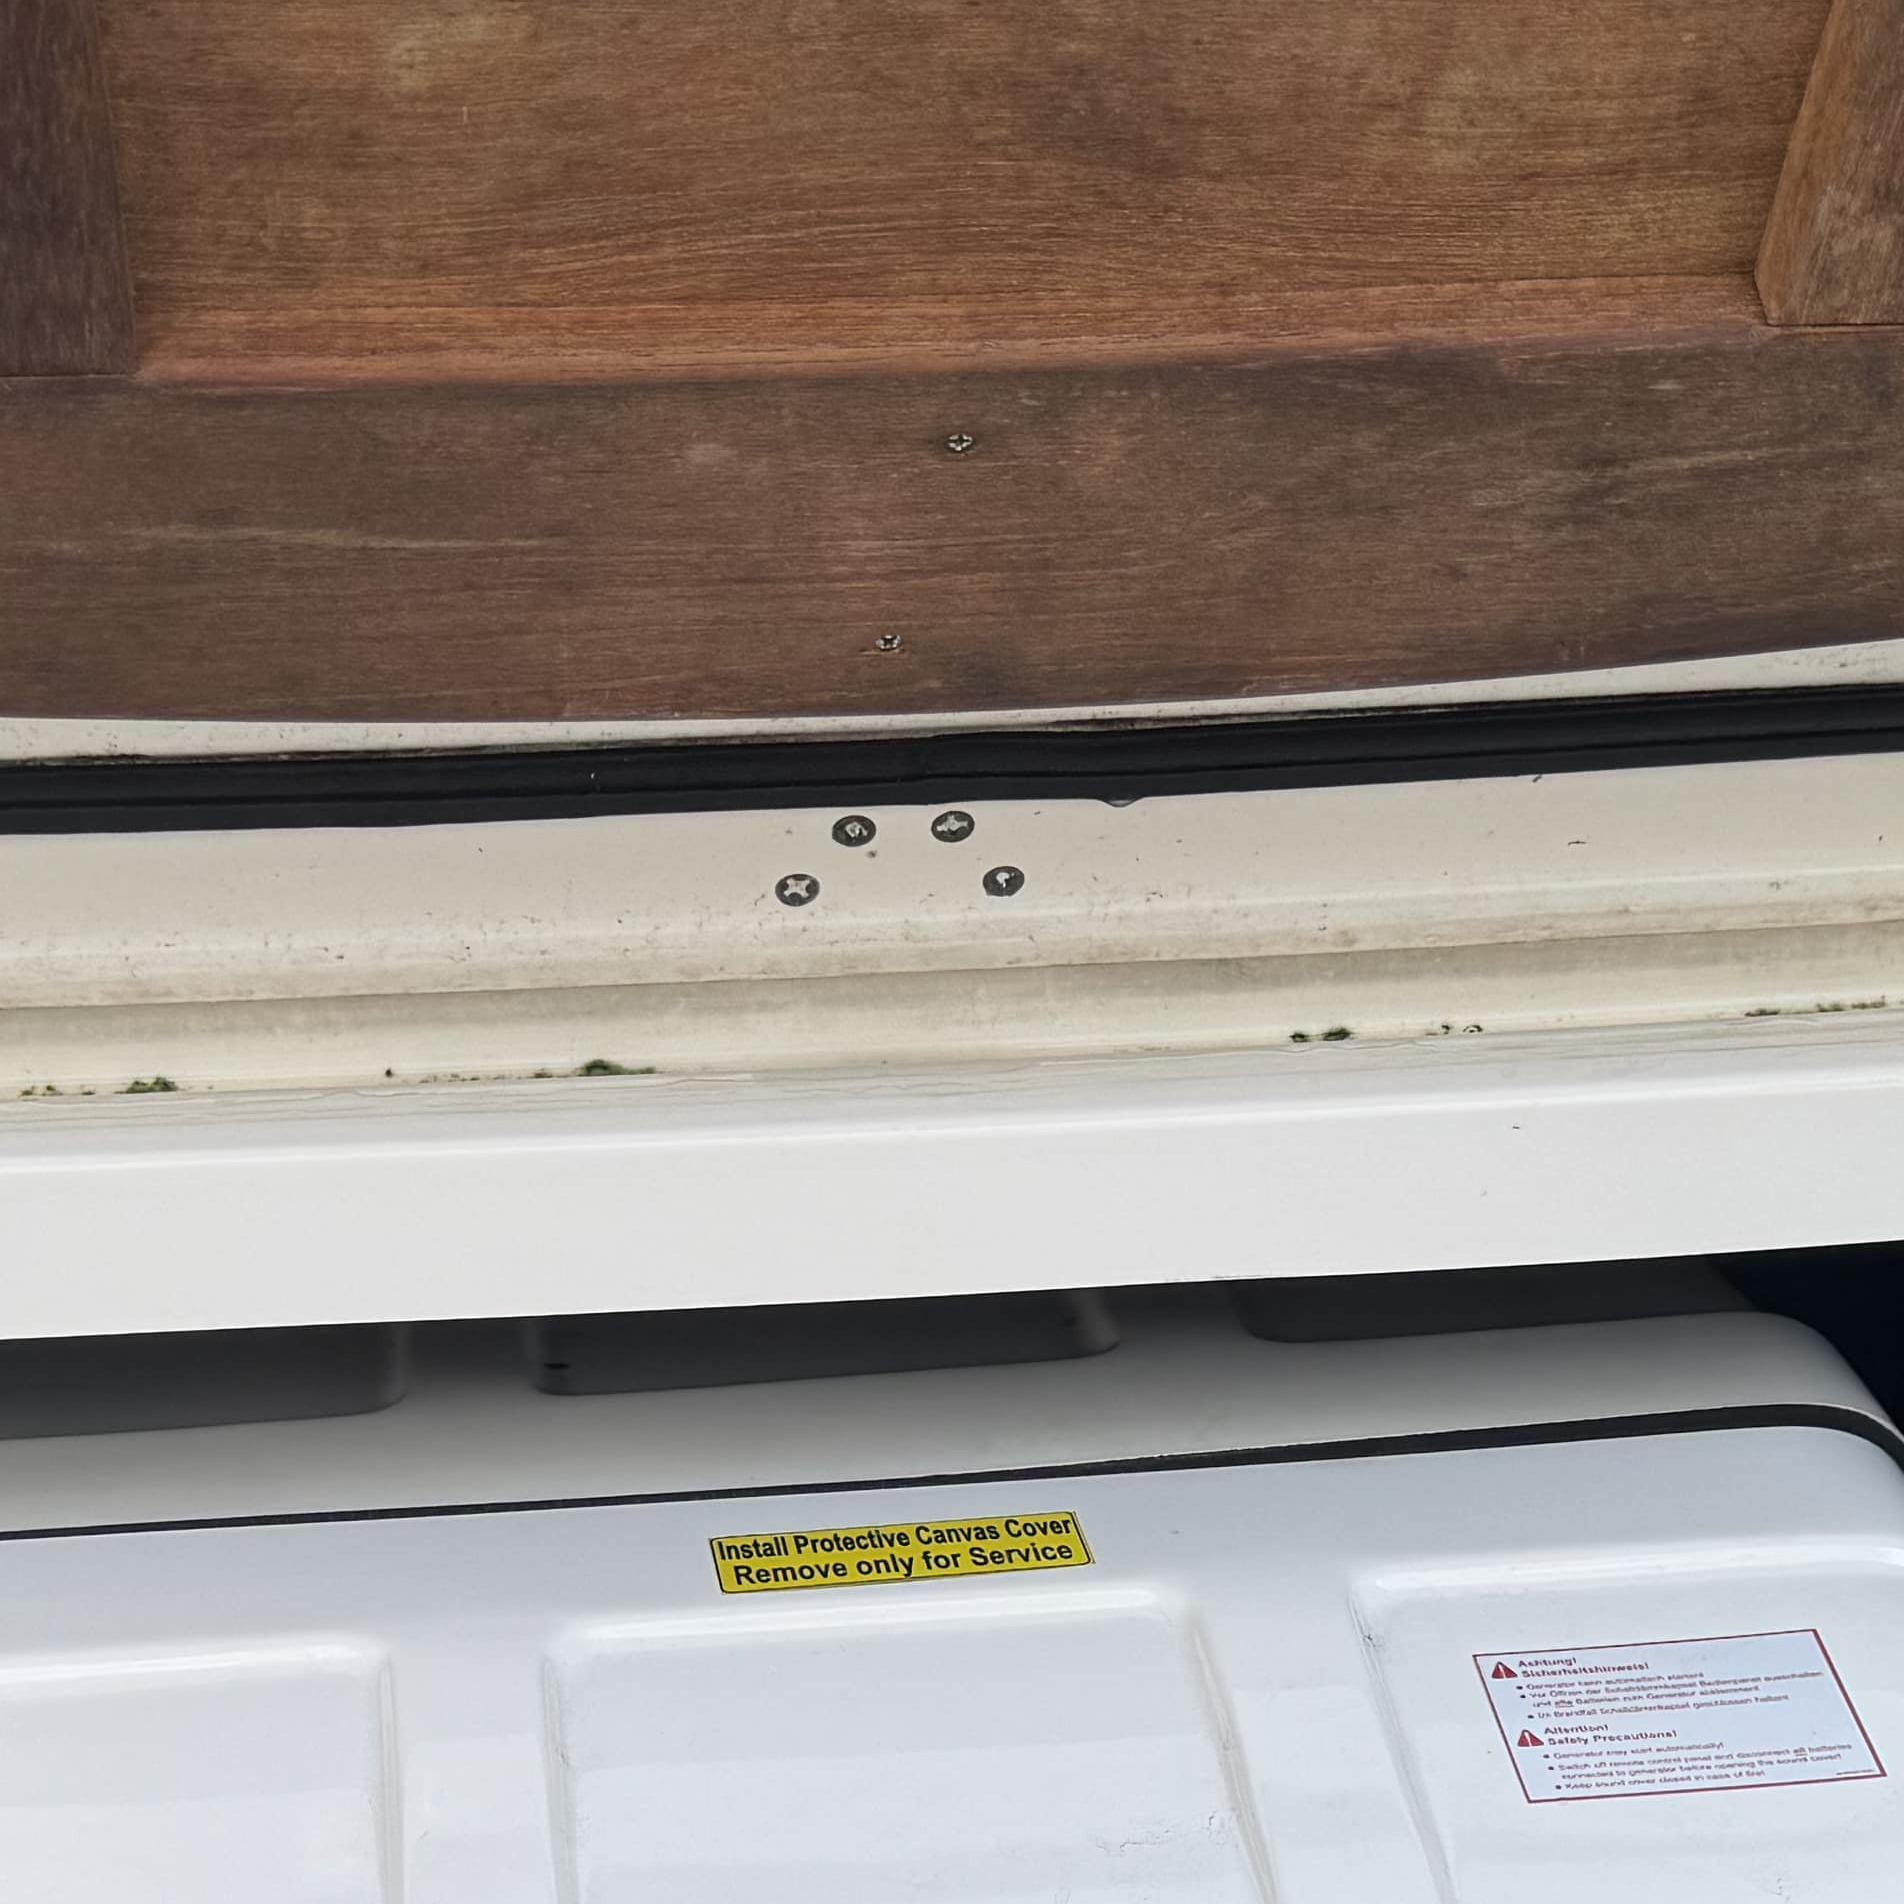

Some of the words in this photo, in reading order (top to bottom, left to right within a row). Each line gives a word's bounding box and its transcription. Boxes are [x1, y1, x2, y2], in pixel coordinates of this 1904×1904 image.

[718, 1537, 788, 1560] Install
[795, 1527, 910, 1555] Protective
[915, 1523, 999, 1547] Canvas
[1004, 1517, 1071, 1538] Cover
[734, 1557, 847, 1585] Remove
[857, 1553, 914, 1577] only
[922, 1550, 961, 1570] for
[971, 1544, 1073, 1567] Service
[1547, 1735, 1590, 1748] Safety
[1591, 1728, 1679, 1744] Precautions!
